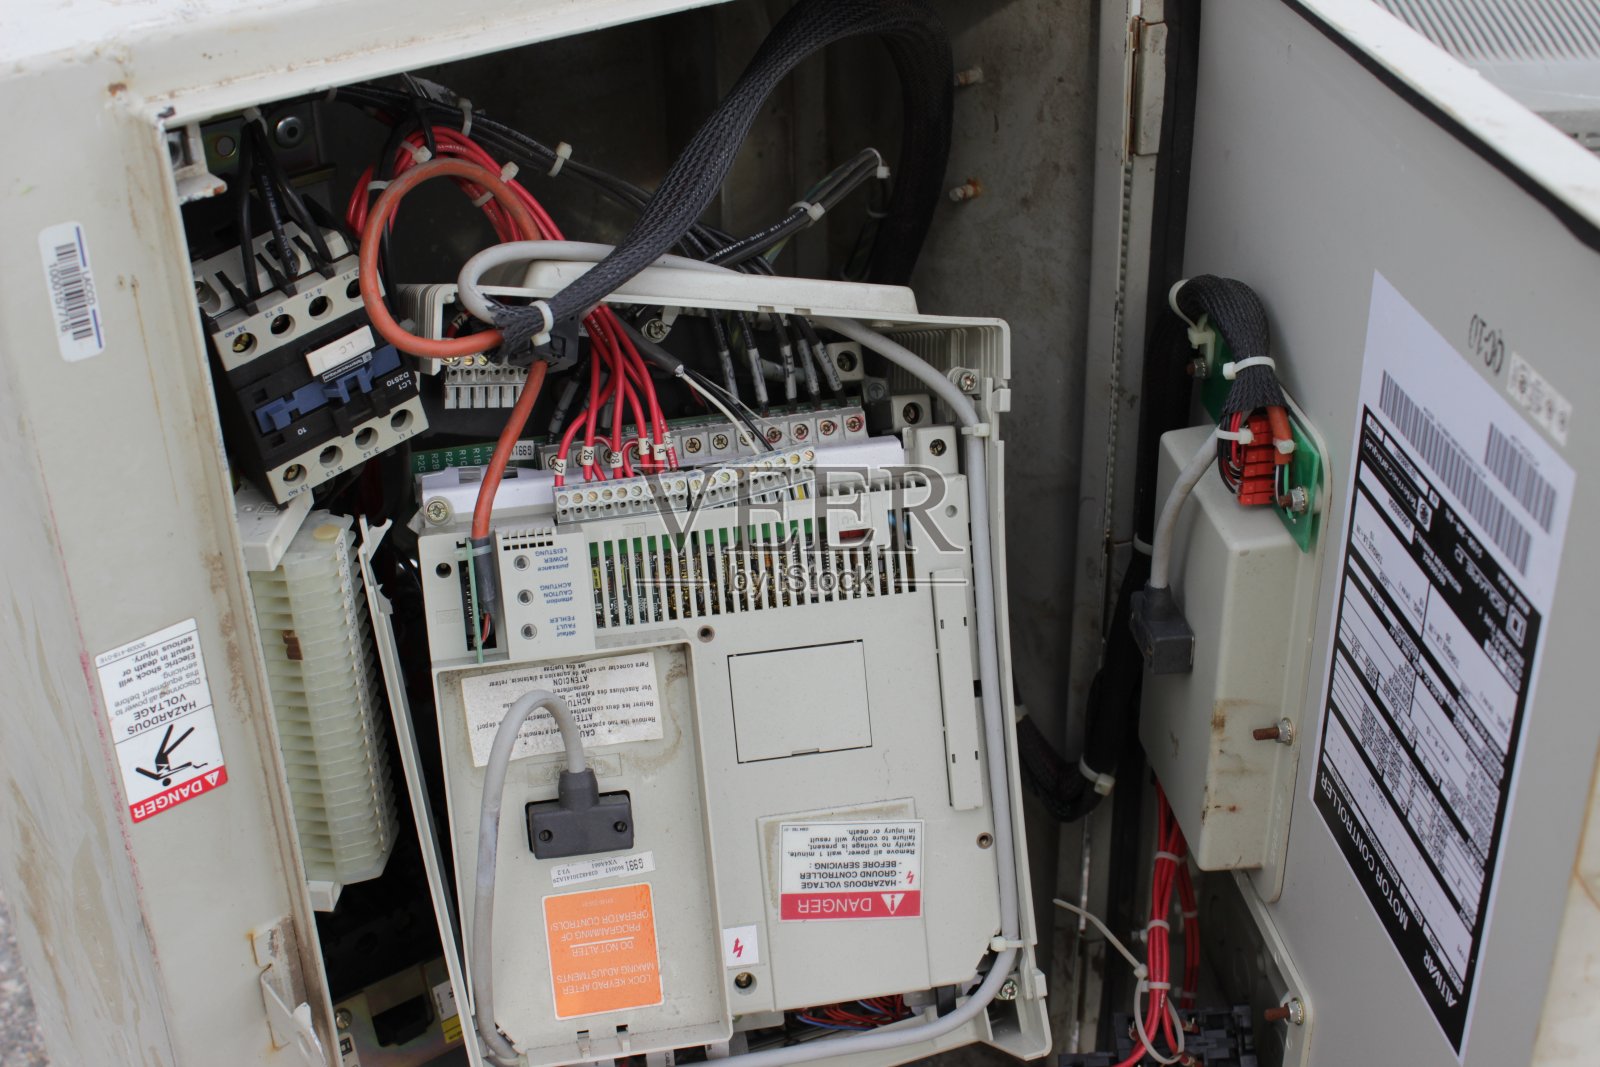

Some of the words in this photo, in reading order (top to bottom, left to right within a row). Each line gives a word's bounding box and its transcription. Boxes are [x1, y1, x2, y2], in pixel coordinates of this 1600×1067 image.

[80, 269, 96, 306] LACCD
[47, 261, 71, 333] 1000157718
[384, 370, 410, 387] D2510
[396, 378, 412, 390] LC1
[295, 425, 307, 436] 10
[584, 449, 593, 461] 26
[610, 453, 620, 464] 28
[555, 462, 564, 474] 27
[1363, 433, 1418, 513] Telemecanique
[534, 547, 568, 557] LEISTUNG
[542, 554, 568, 563] POWER
[538, 581, 572, 591] ACHTUNG
[1464, 557, 1507, 621] SQUARE
[542, 588, 573, 598] CAUTION
[554, 622, 576, 631] FAULT
[160, 634, 193, 653] serious
[169, 642, 195, 659] result
[159, 653, 169, 663] in
[163, 650, 196, 670] Electric
[132, 657, 158, 673] death
[120, 667, 132, 677] or
[134, 664, 163, 682] shock
[184, 668, 200, 680] this
[117, 675, 134, 688] will
[140, 673, 184, 697] equipment
[551, 673, 588, 686] ATENCION
[158, 676, 201, 699] Disconnect
[113, 691, 140, 709] before
[123, 695, 149, 713] power
[148, 693, 159, 703] all
[114, 706, 124, 716] to
[131, 691, 187, 721] VOLTAGE
[125, 698, 197, 736] HAZARDOUS
[131, 778, 204, 820] DANGER
[1319, 767, 1375, 876] CONTROLLER
[845, 827, 869, 835] death.
[883, 826, 905, 834] injury
[850, 834, 878, 842] comply
[893, 840, 915, 848] verify
[851, 841, 878, 849] voltage
[845, 848, 870, 856] power,
[813, 860, 860, 870] SERVICING
[862, 859, 897, 868] BEFORE
[798, 870, 857, 880] CONTROLLER
[859, 869, 897, 878] GROUND
[799, 880, 841, 889] VOLTAGE
[843, 878, 896, 888] HAZARDOUS
[796, 896, 872, 913] DANGER
[1374, 863, 1409, 934] MOTOR
[601, 908, 649, 924] OPERATOR
[574, 921, 641, 939] PROGRAMMING
[559, 931, 573, 942] OF
[571, 944, 599, 957] ALTER
[600, 941, 619, 953] NOT
[620, 939, 634, 950] DO
[620, 960, 655, 974] MAKING
[555, 965, 619, 984] ADJUSTMENTS
[626, 973, 651, 985] LOCK
[1421, 944, 1458, 1017] ALTIVAR
[561, 982, 590, 995] AFTER
[591, 976, 626, 990] KEYPAD
